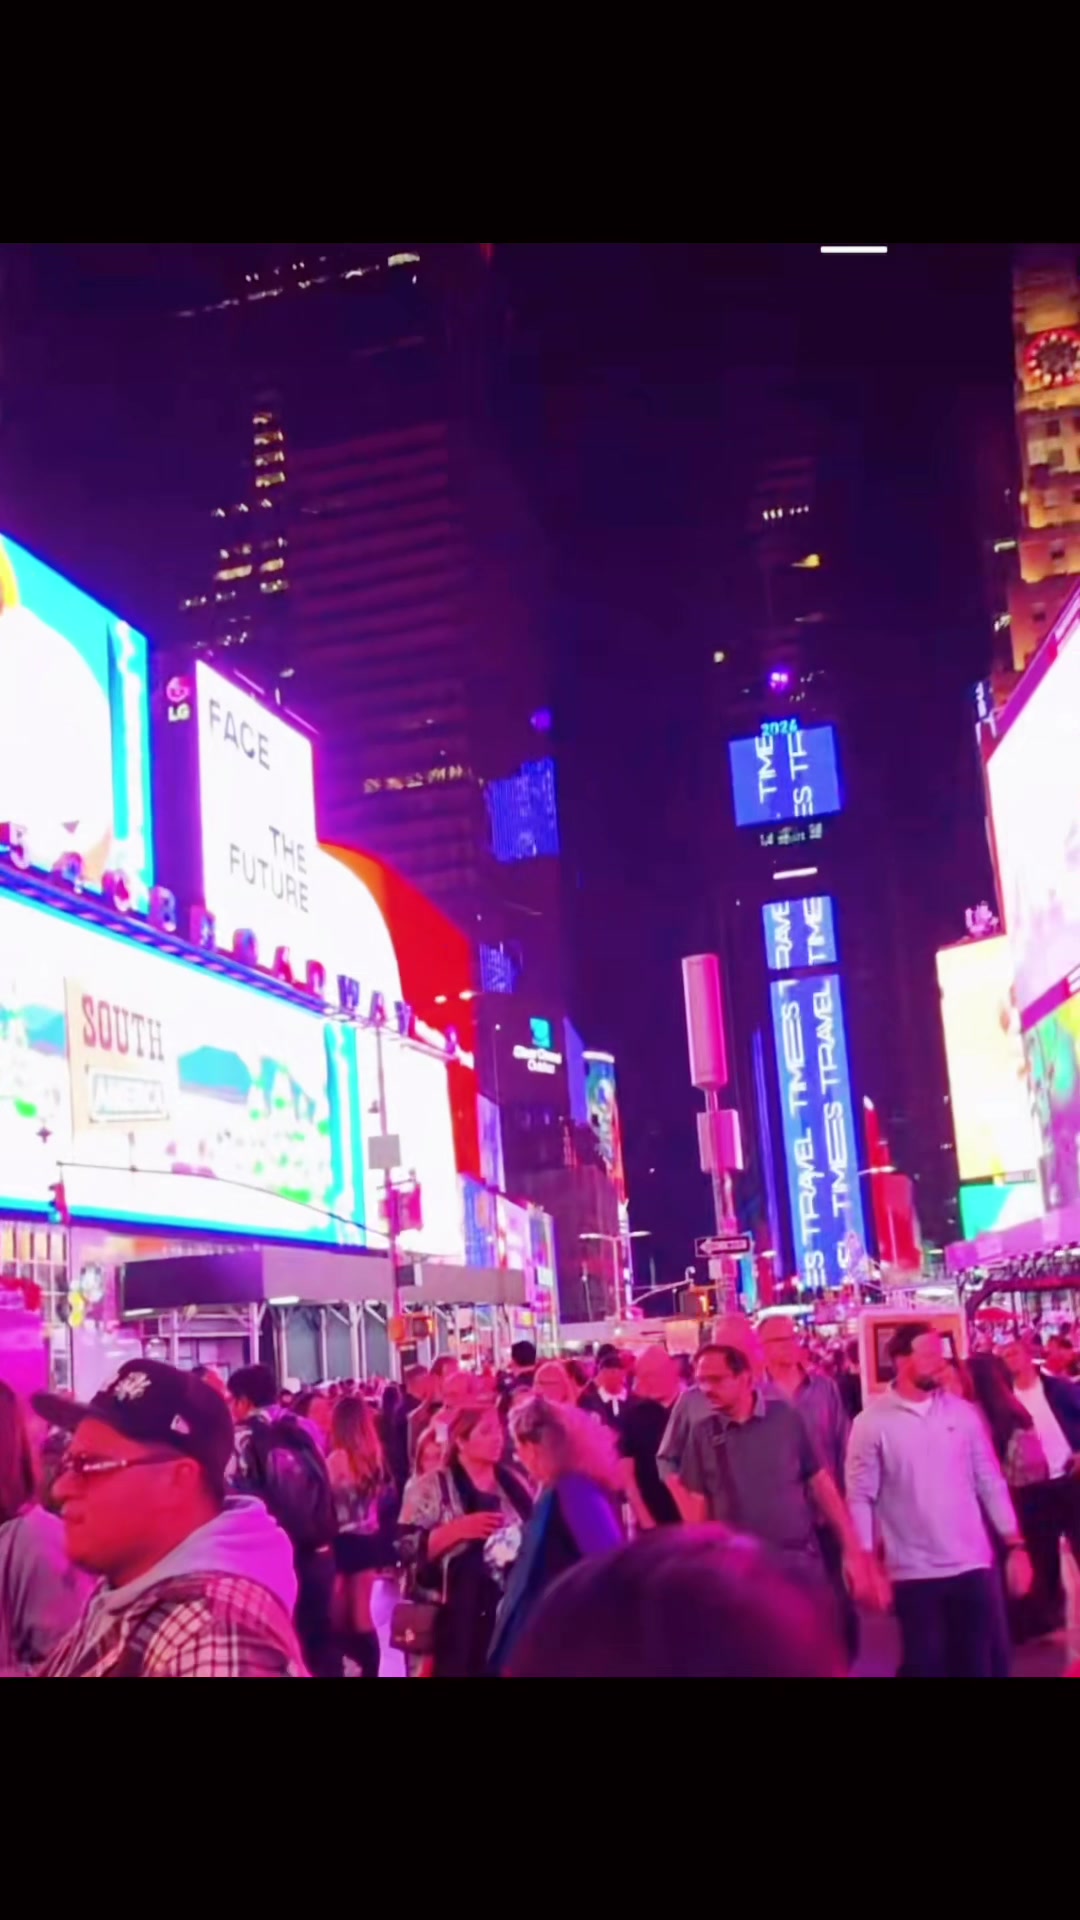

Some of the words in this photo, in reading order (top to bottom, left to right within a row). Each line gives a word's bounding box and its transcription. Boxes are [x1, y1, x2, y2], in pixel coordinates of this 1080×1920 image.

[168, 703, 190, 722] LG
[209, 697, 270, 771] FACE
[761, 718, 798, 737] 2026
[755, 735, 778, 804] TIME
[230, 843, 309, 913] FUTURE
[268, 825, 307, 874] THE
[81, 993, 164, 1061] SOUTH
[781, 1001, 807, 1117] TIMES
[812, 980, 840, 1095] TRAVEL
[793, 1128, 822, 1246] TRAVEL
[823, 1101, 850, 1218] TIMES
